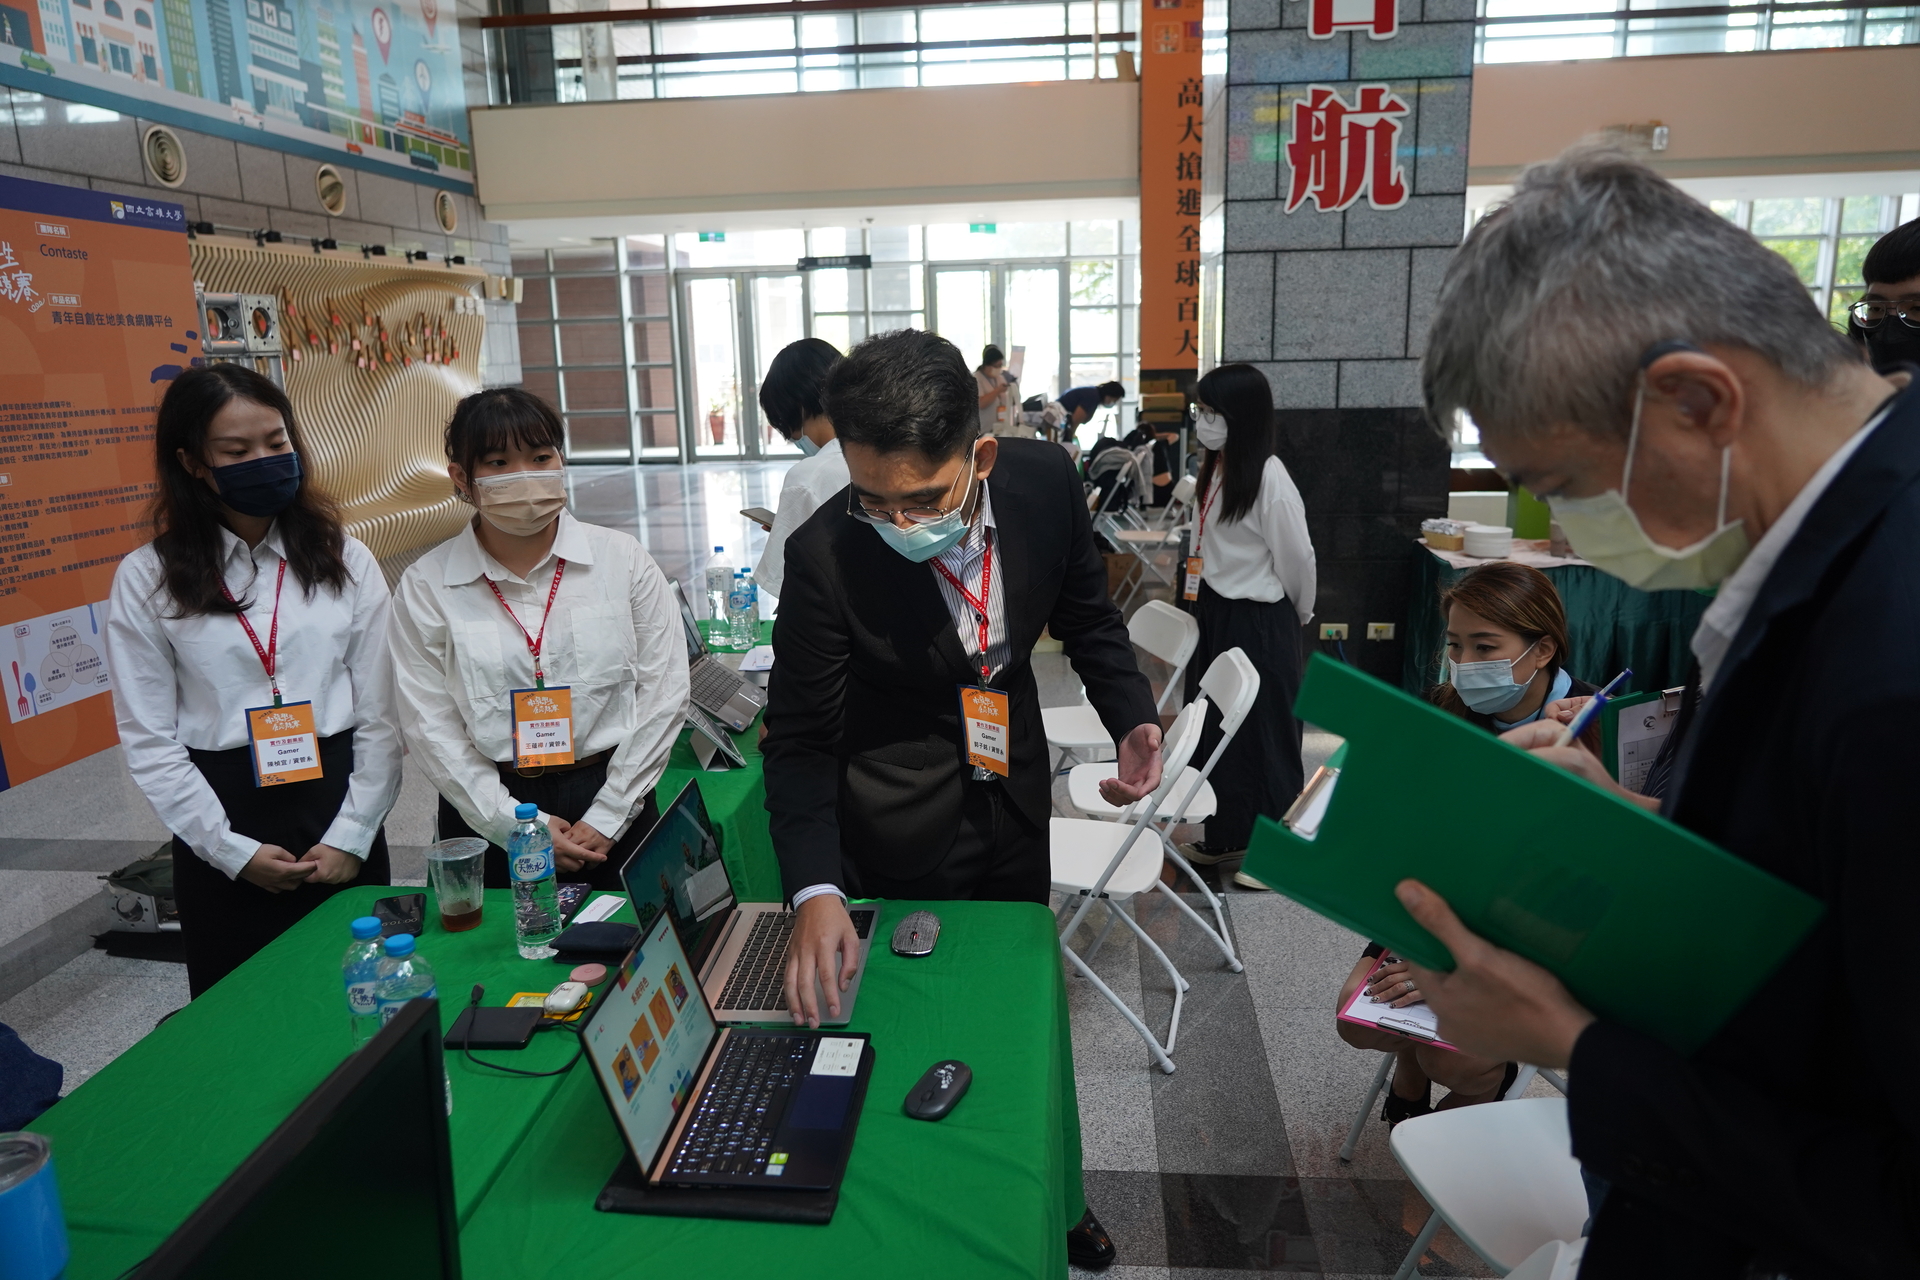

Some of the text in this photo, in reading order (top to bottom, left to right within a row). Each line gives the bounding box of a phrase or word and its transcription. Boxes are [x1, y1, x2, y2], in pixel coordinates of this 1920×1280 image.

[125, 203, 183, 221] 國立高雄大學
[1175, 78, 1202, 357] 高大搶進全球百大
[39, 224, 67, 236] 團隊名稱
[39, 243, 89, 261] Contaste
[51, 295, 78, 306] 作品名稱
[51, 310, 174, 329] 青年自創在地美食網購平台
[981, 732, 997, 742] Gamer
[277, 747, 300, 756] Gamer
[518, 862, 542, 873] 天然水
